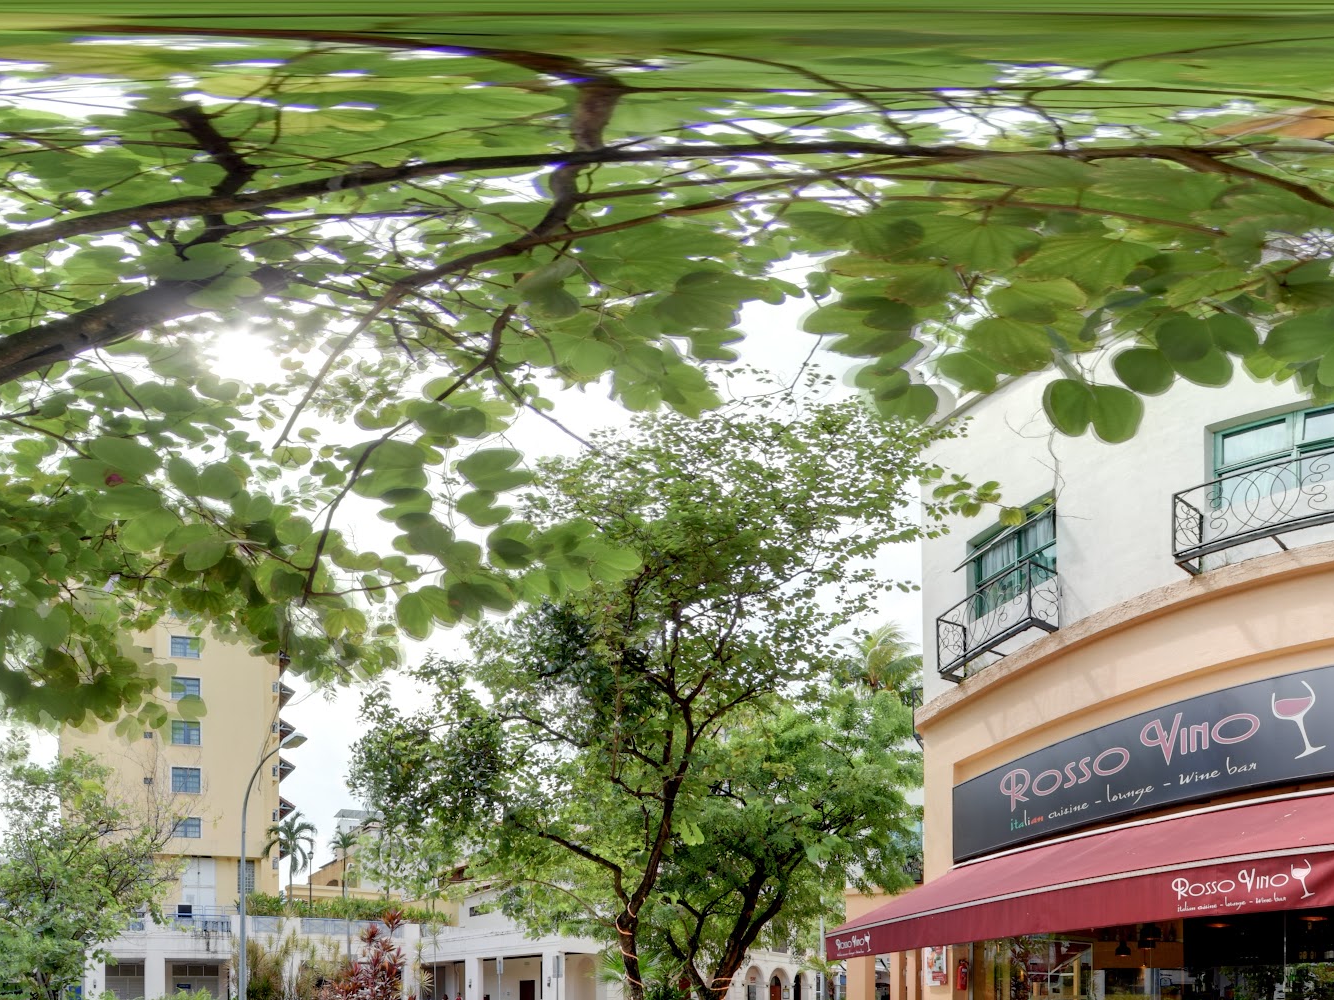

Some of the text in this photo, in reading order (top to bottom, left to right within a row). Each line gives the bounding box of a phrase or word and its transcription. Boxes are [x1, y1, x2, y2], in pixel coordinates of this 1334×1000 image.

[1010, 809, 1044, 831] italian
[1048, 802, 1089, 819] cuisine
[1106, 783, 1155, 805] lounge
[1226, 756, 1257, 775] bar
[1177, 901, 1196, 912] italian
